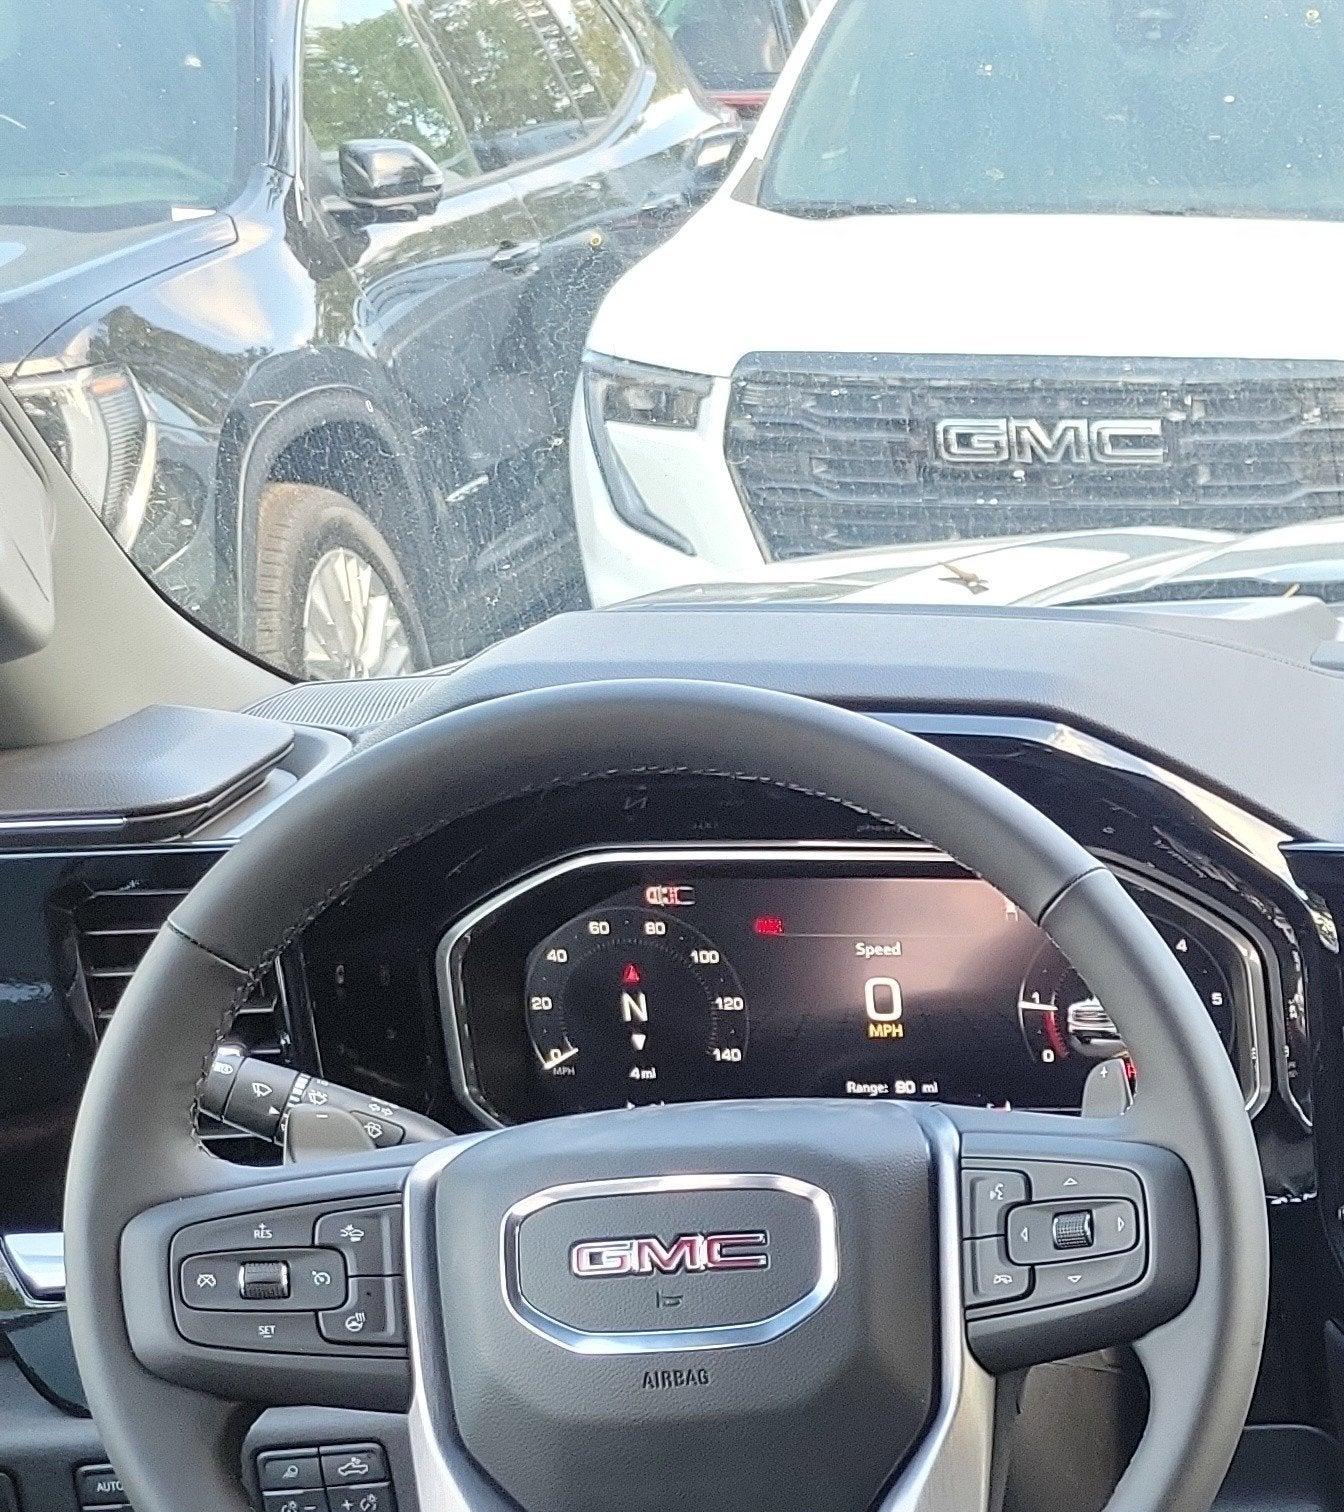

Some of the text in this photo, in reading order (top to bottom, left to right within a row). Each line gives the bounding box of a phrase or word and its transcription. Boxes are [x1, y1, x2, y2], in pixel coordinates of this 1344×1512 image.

[935, 417, 1166, 463] GMC
[589, 921, 610, 935] 60
[645, 921, 666, 935] 80
[855, 942, 902, 958] Speed
[1176, 939, 1188, 952] 4
[546, 949, 568, 963] 40
[690, 950, 720, 964] 100
[531, 997, 552, 1010] 20
[715, 997, 744, 1010] 120
[865, 977, 902, 1021] 0
[1031, 991, 1039, 1003] 1
[1211, 992, 1222, 1005] 5
[621, 991, 648, 1022] N
[869, 1023, 904, 1038] MPH
[712, 1048, 742, 1062] 140
[1042, 1049, 1055, 1063] 0
[553, 1066, 576, 1076] MPH
[629, 1067, 657, 1079] 4 mi
[846, 1081, 889, 1097] Range:
[921, 1081, 939, 1094] mi
[254, 1229, 273, 1240] RES
[572, 1231, 767, 1276] GMC
[259, 1325, 276, 1335] SET
[643, 1368, 710, 1389] AIRBAG
